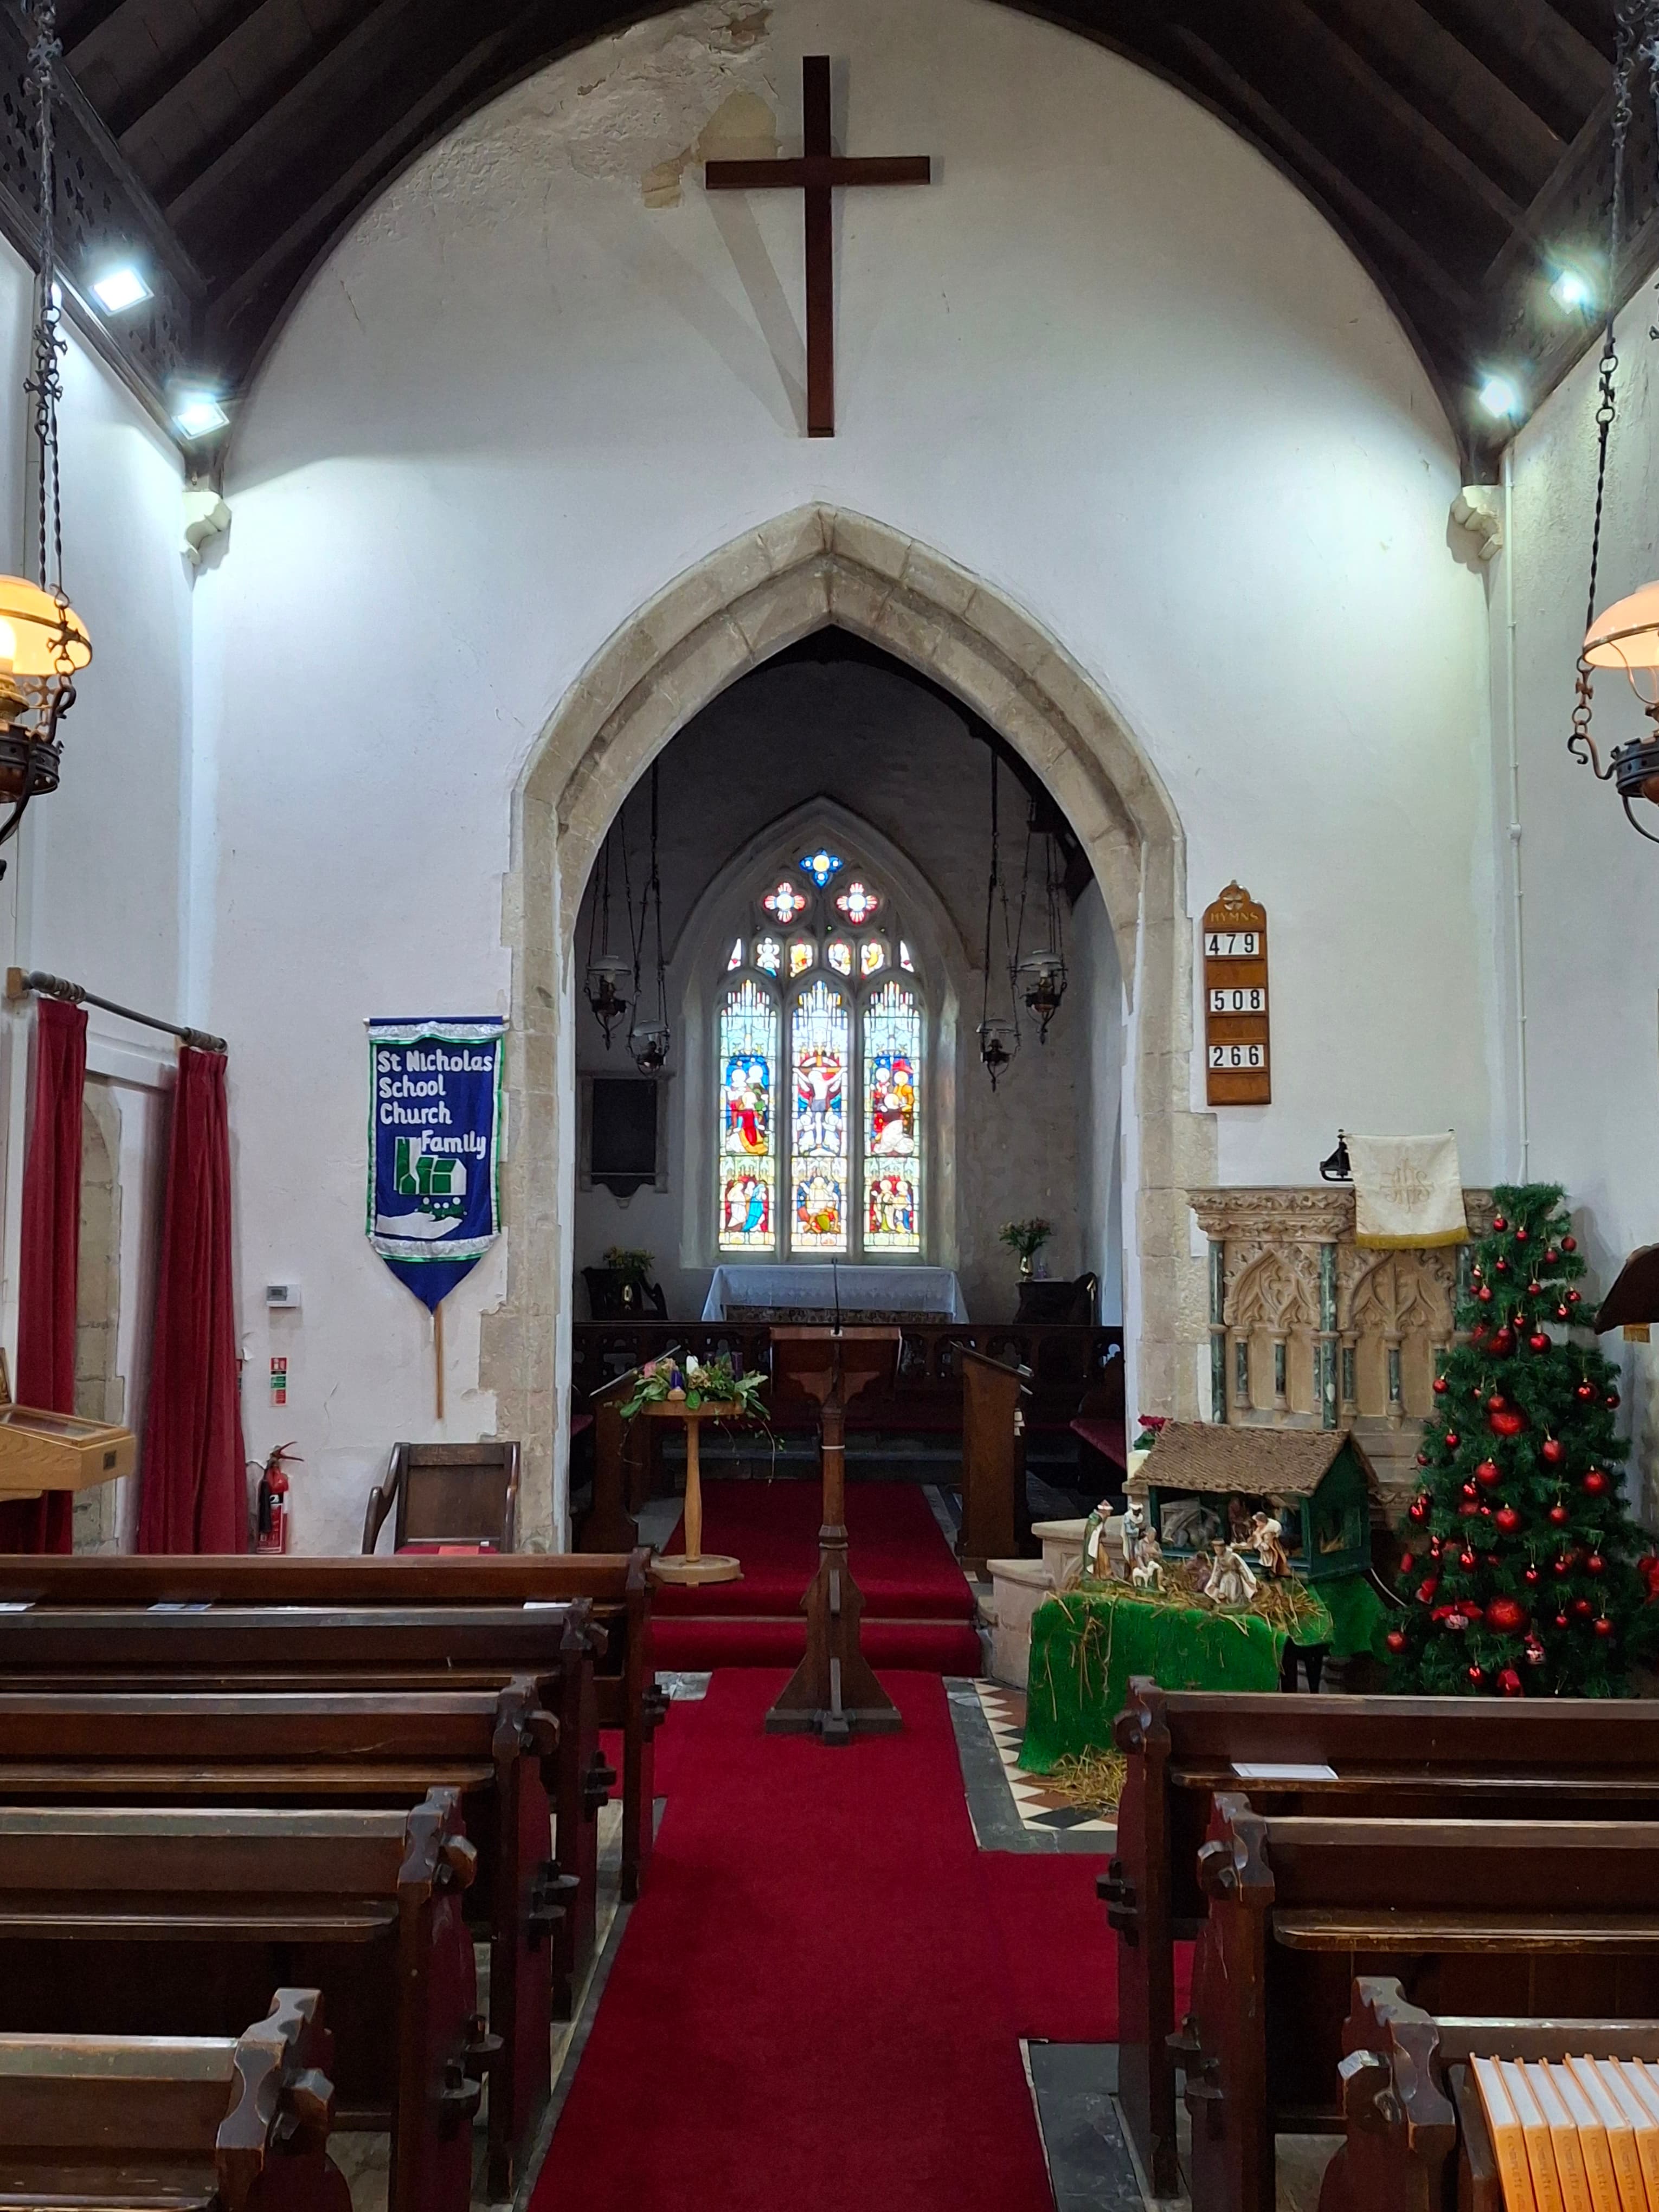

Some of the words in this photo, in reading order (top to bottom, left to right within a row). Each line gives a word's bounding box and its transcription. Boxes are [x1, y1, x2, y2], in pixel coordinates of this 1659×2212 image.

[1211, 912, 1258, 922] HYMNS
[1209, 933, 1253, 955] 479
[1214, 989, 1260, 1010] 508
[378, 1051, 402, 1073] St
[407, 1049, 493, 1072] Nicholas
[1213, 1046, 1259, 1066] 266
[379, 1073, 446, 1098] School
[381, 1101, 453, 1124] Church
[422, 1129, 486, 1160] Family
